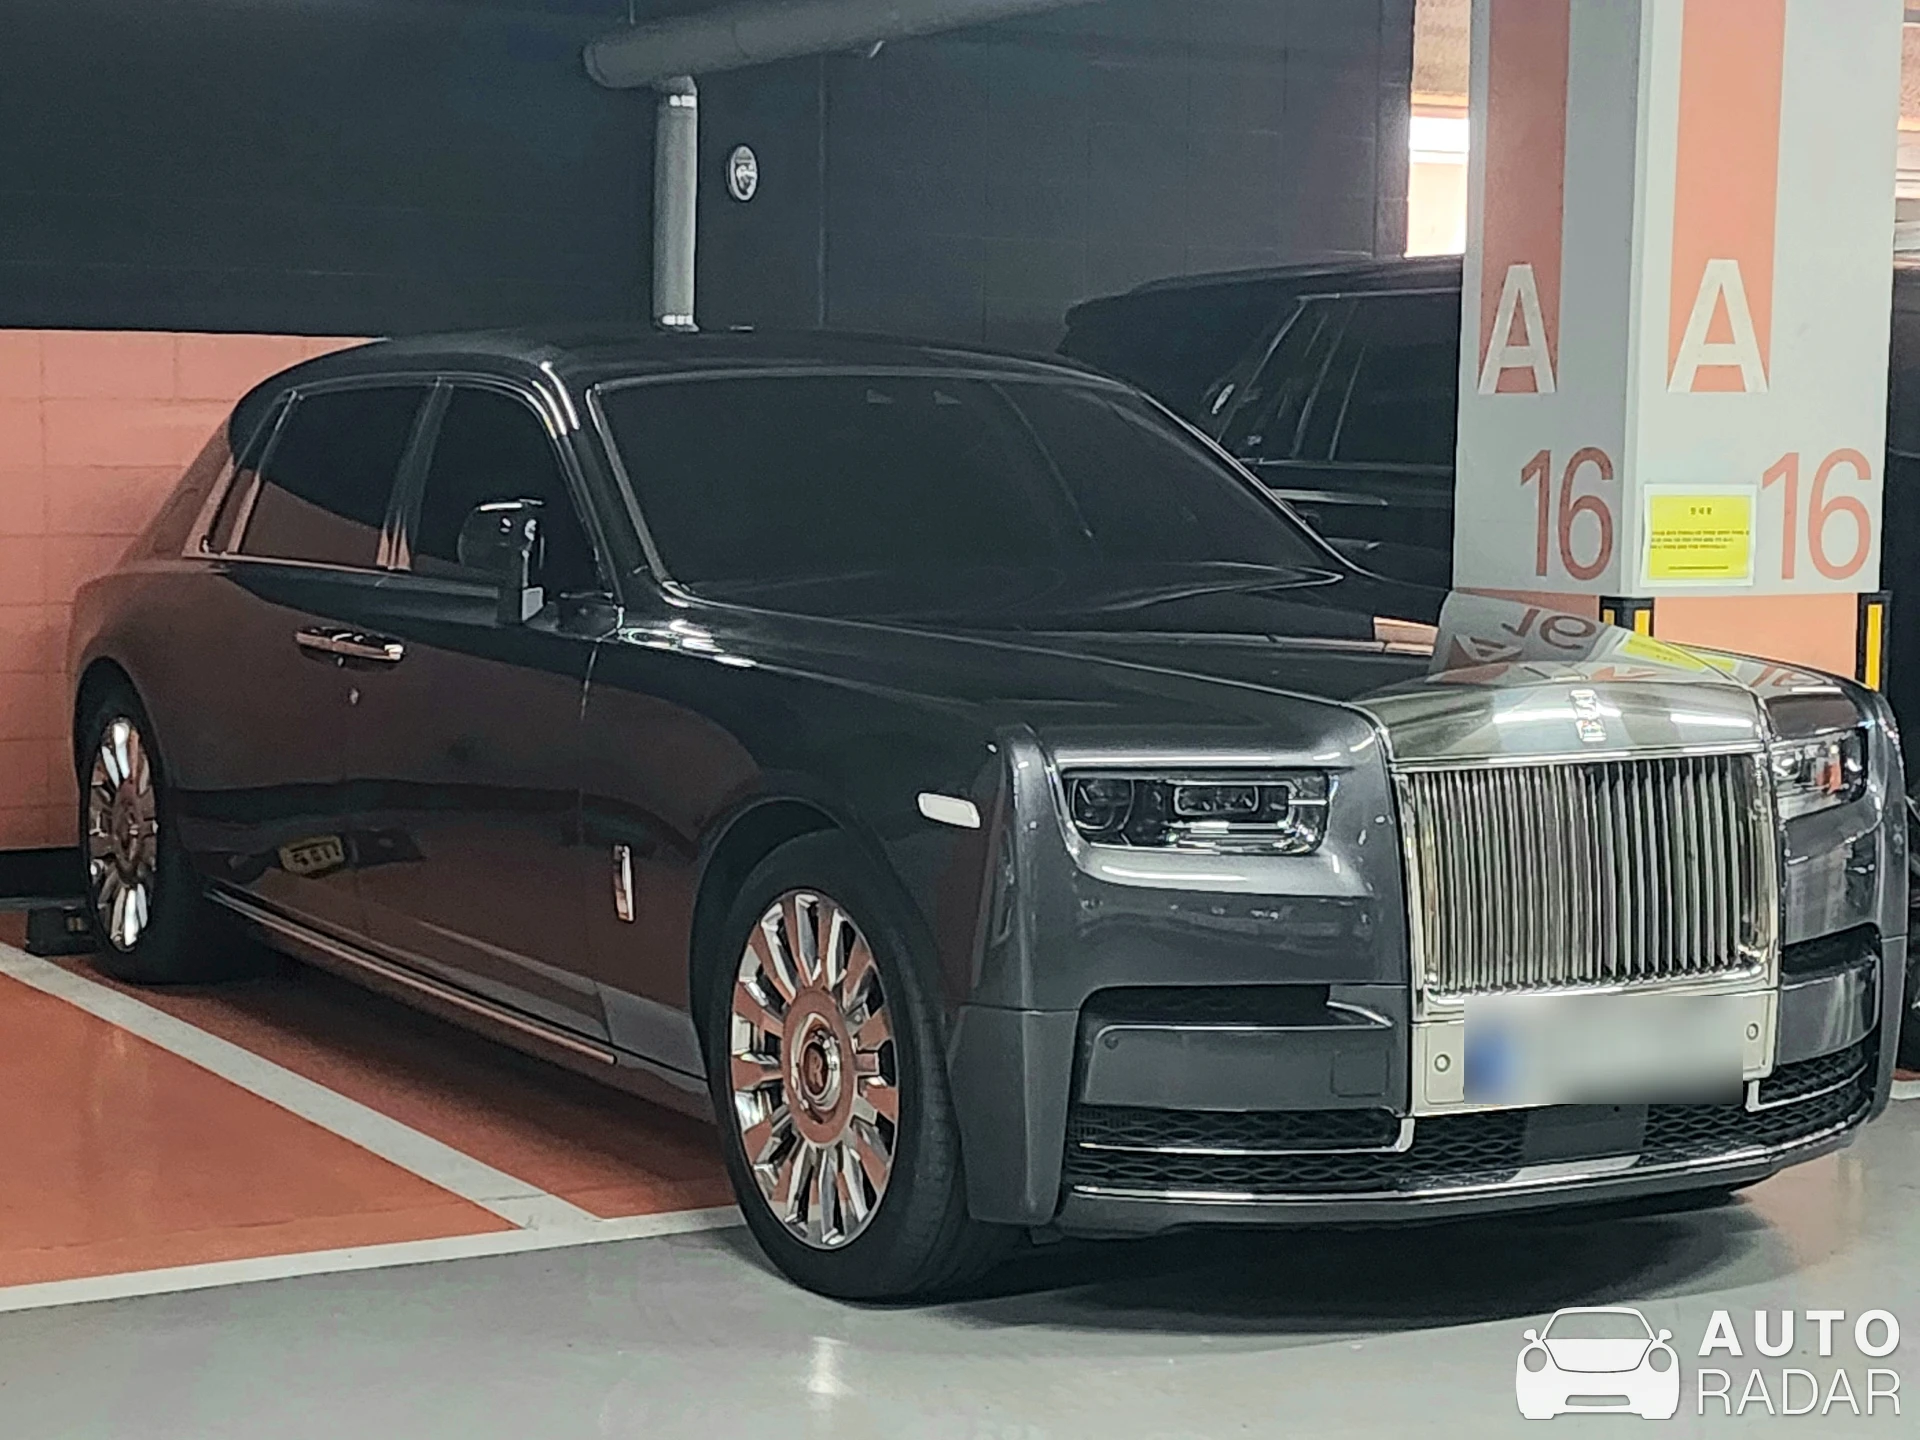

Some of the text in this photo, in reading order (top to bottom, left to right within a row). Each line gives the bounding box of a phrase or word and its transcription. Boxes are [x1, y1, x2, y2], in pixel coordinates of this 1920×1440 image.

[1478, 263, 1557, 395] A
[1667, 258, 1769, 394] A
[1520, 446, 1613, 581] 16
[1761, 447, 1872, 580] 16
